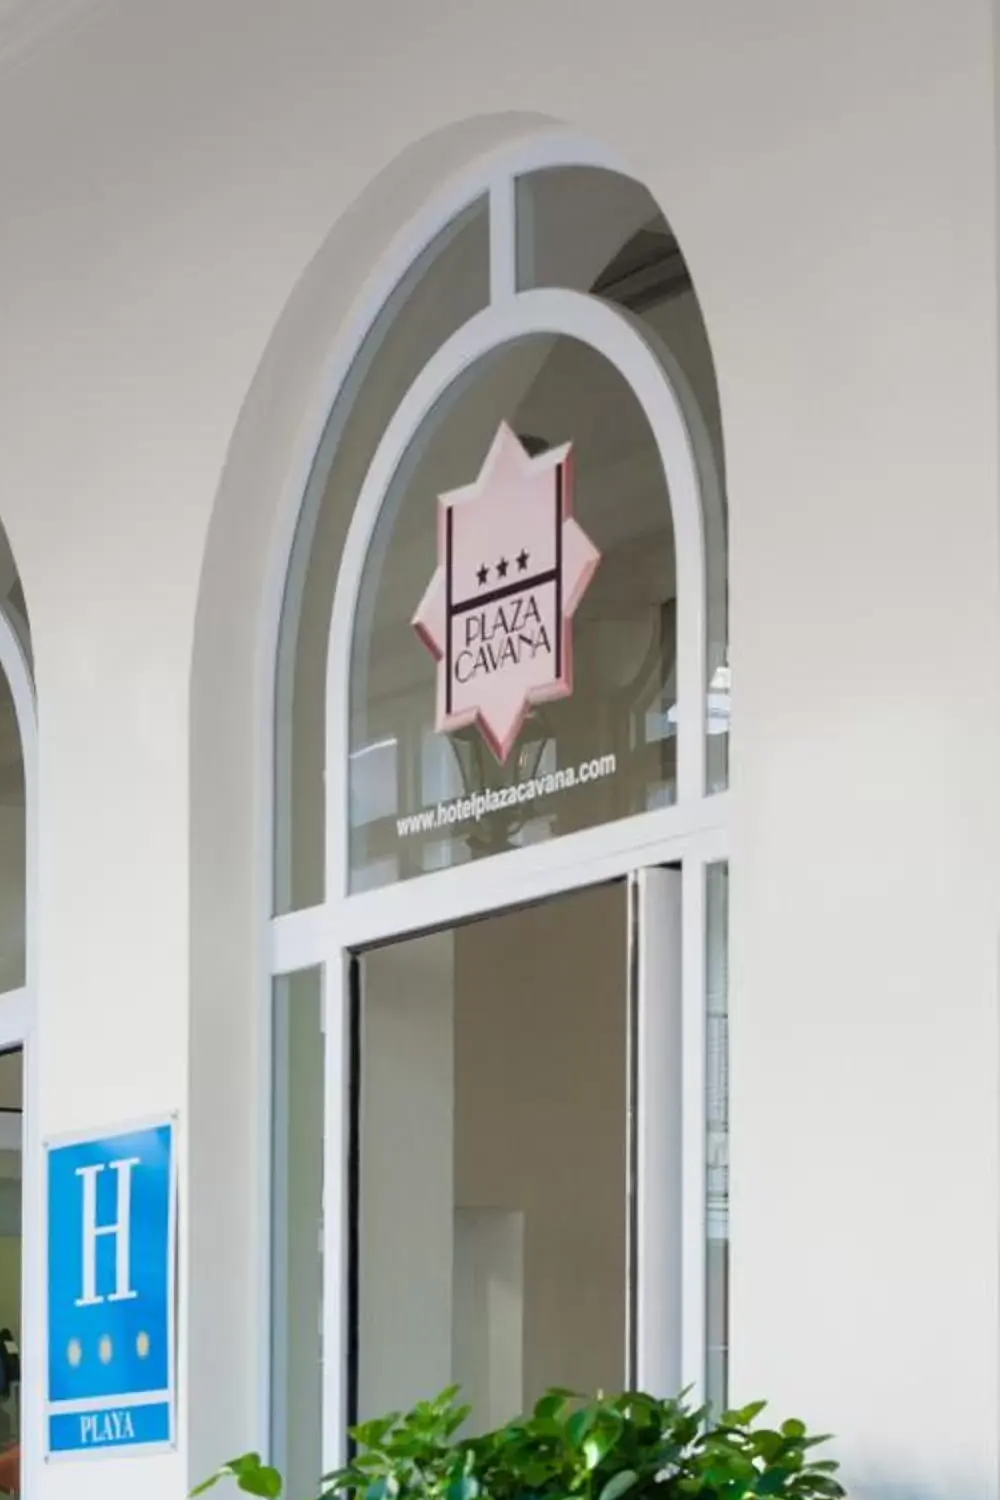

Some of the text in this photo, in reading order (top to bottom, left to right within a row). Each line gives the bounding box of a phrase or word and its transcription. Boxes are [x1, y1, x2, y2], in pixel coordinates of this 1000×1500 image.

[465, 594, 541, 646] PLAZA
[454, 625, 551, 684] CAVANA
[396, 752, 616, 836] www.hotelplazacavana.com
[74, 1157, 141, 1307] H
[80, 1410, 135, 1444] PLAYA
